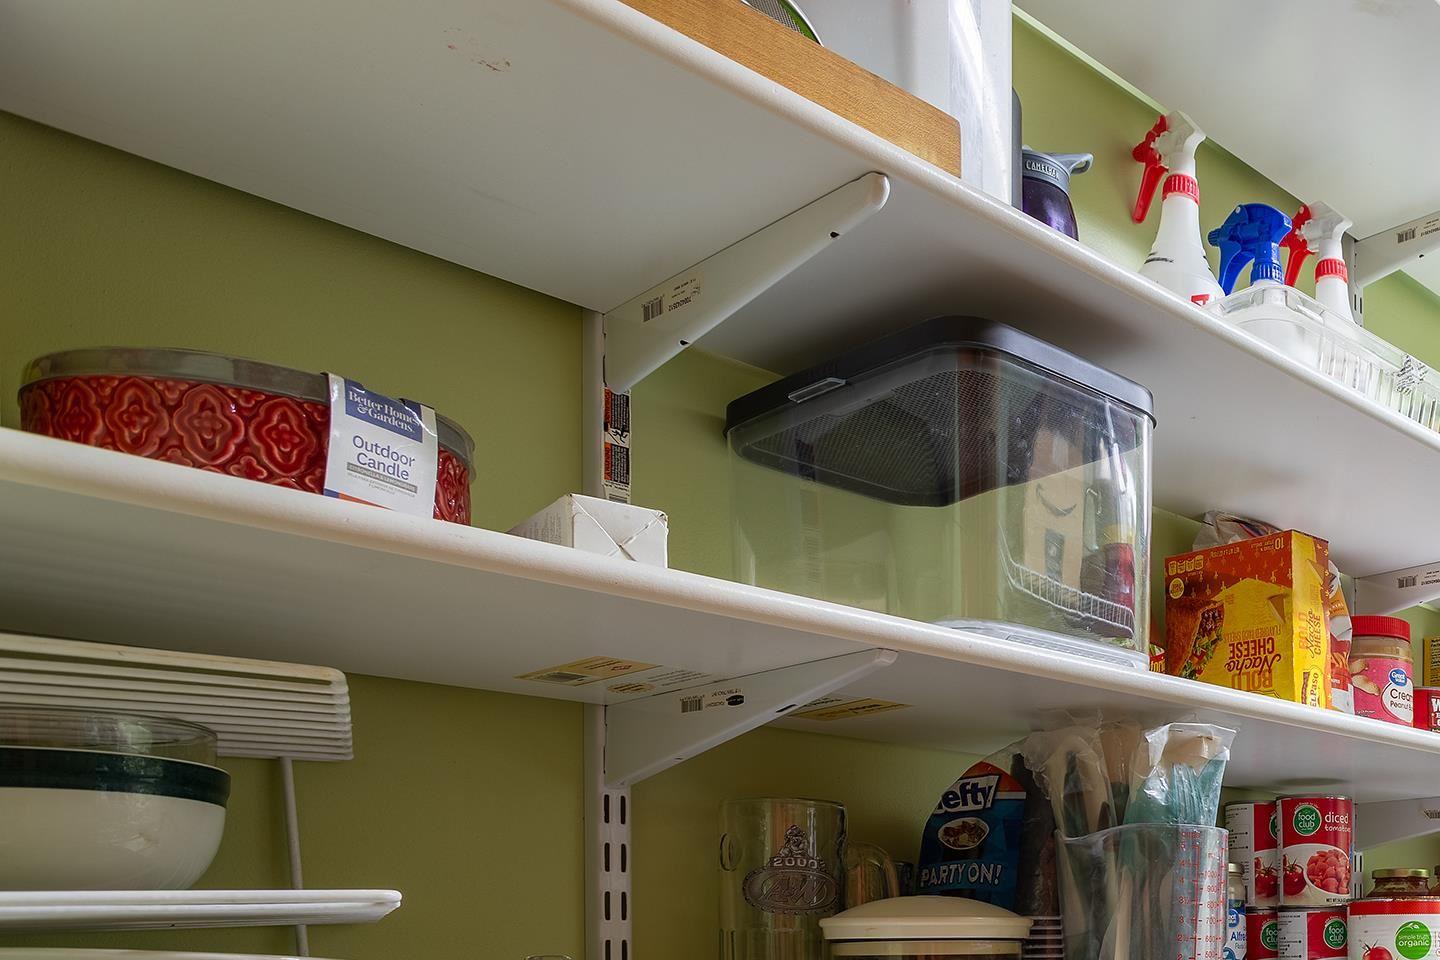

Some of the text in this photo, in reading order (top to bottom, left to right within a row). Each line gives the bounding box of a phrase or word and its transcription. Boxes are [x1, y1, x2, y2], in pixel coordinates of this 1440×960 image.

[348, 390, 383, 410] Better
[368, 408, 414, 433] Gardens
[352, 435, 415, 467] Outdoor
[356, 452, 409, 480] Candle
[1313, 615, 1321, 655] CHEESE
[1228, 636, 1275, 660] CHEESE
[1224, 653, 1282, 676] Nacho
[1390, 688, 1413, 702] Crea
[937, 781, 994, 810] efty
[1298, 812, 1316, 821] food
[1298, 820, 1315, 829] club
[1324, 811, 1349, 824] diced
[773, 857, 818, 869] 2000
[920, 862, 1002, 887] PARTY ON!
[1230, 931, 1247, 942] Alfre
[1328, 925, 1346, 935] food
[1329, 933, 1344, 942] club
[1398, 939, 1430, 948] organic
